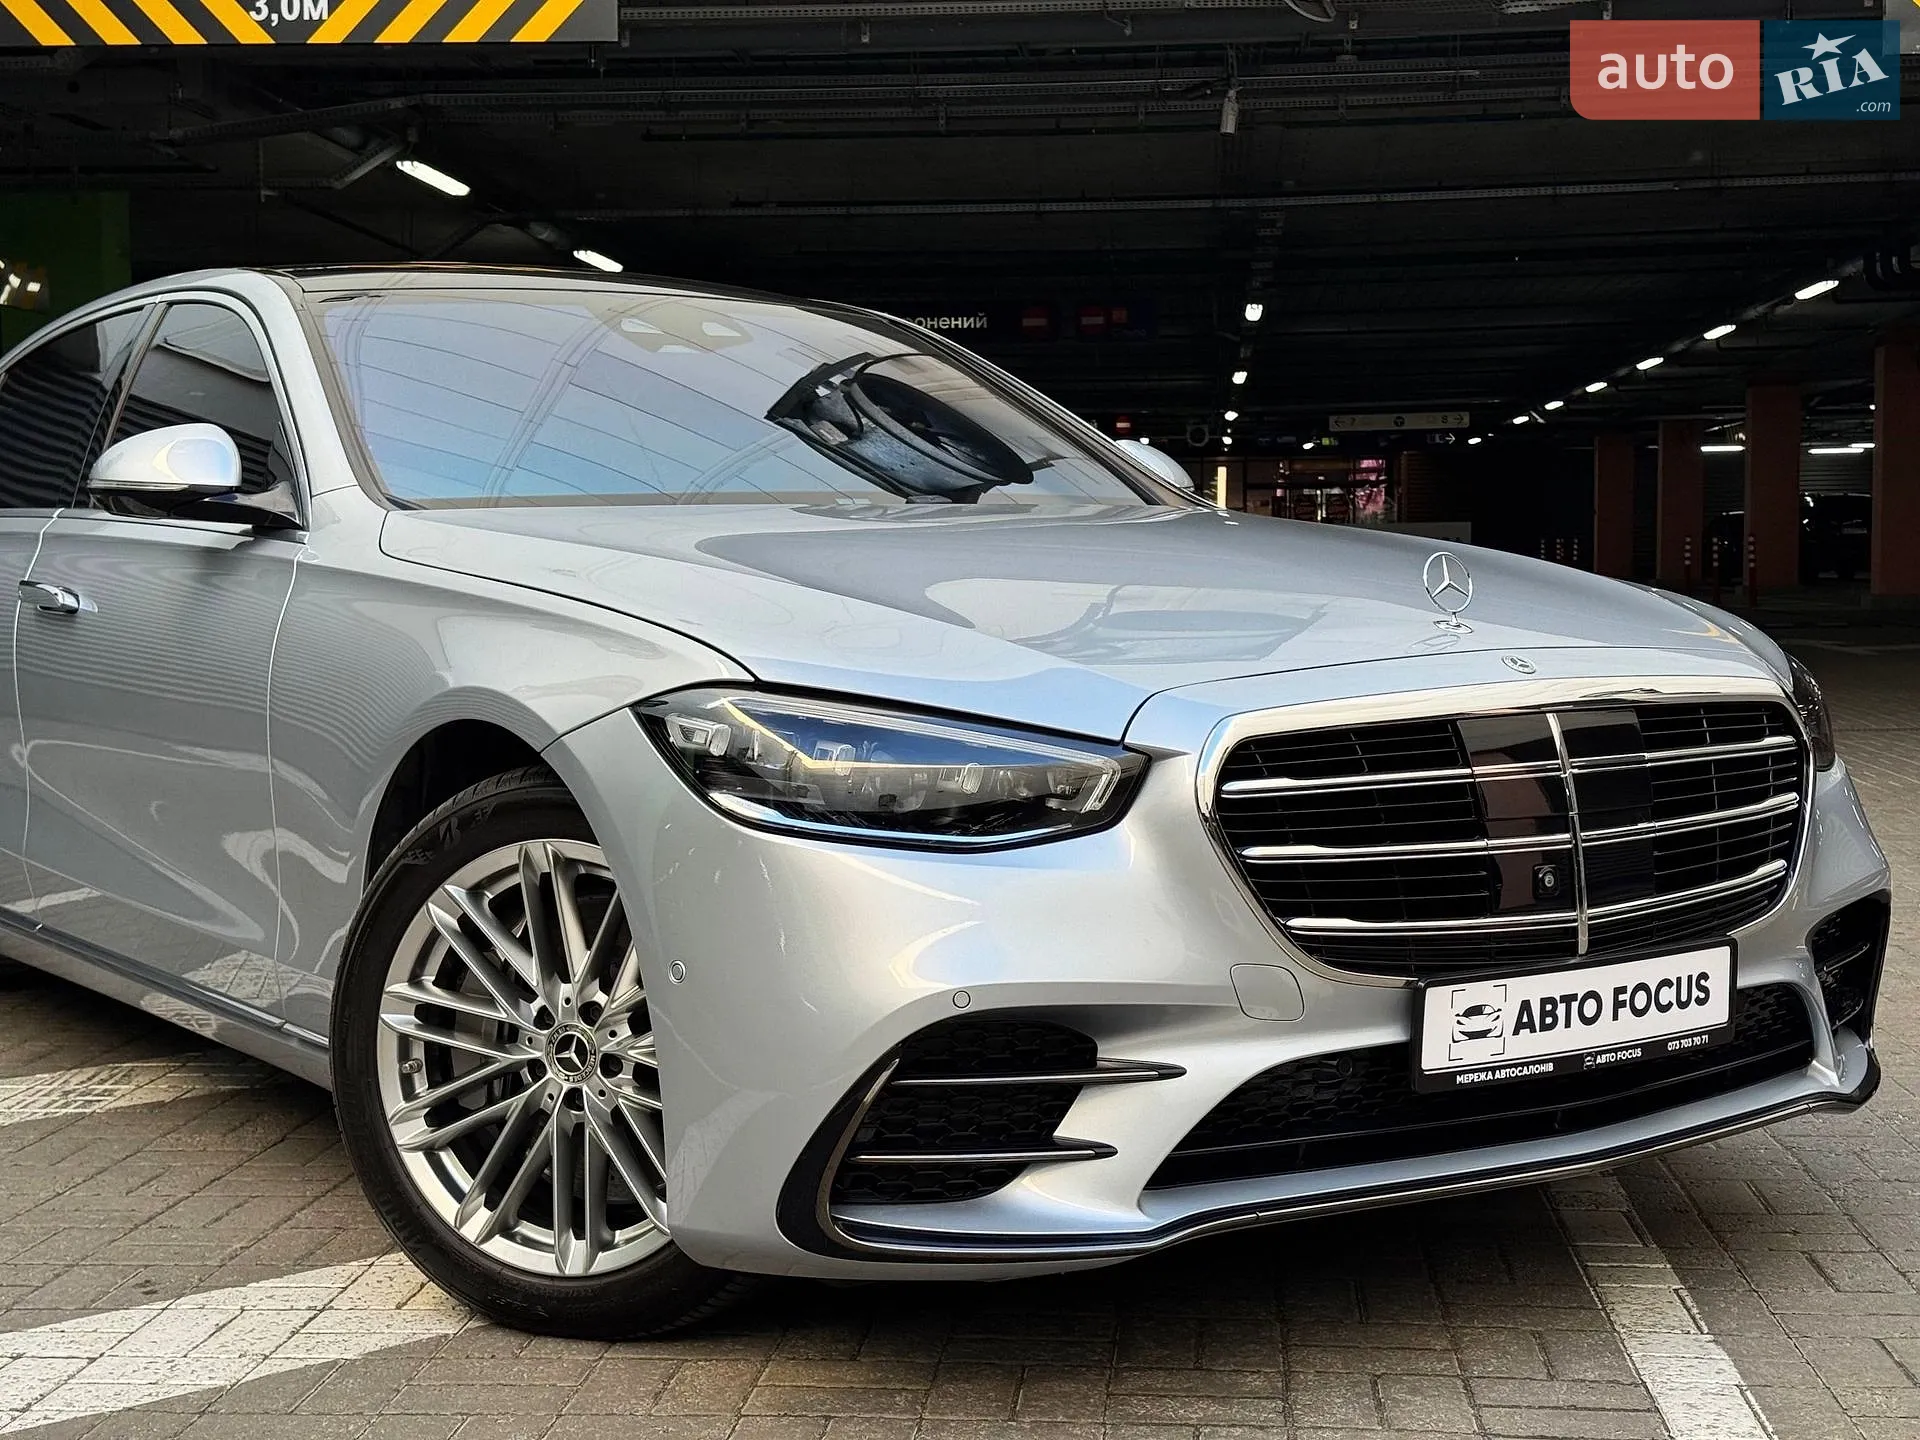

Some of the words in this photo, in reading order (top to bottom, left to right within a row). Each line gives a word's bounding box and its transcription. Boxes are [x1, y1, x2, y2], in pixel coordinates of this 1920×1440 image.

[905, 312, 988, 329] онений
[1512, 990, 1603, 1036] АВТО
[1612, 971, 1711, 1022] FOCUS
[1667, 1041, 1680, 1051] 073
[1680, 1038, 1692, 1049] 703
[1692, 1037, 1701, 1047] 70
[1702, 1035, 1709, 1044] 71
[1596, 1052, 1616, 1064] АВТО
[1617, 1048, 1642, 1061] FOCUS
[1456, 1070, 1493, 1085] МЕРЕЖА
[1494, 1062, 1554, 1081] АВТОСАЛОНІВ
